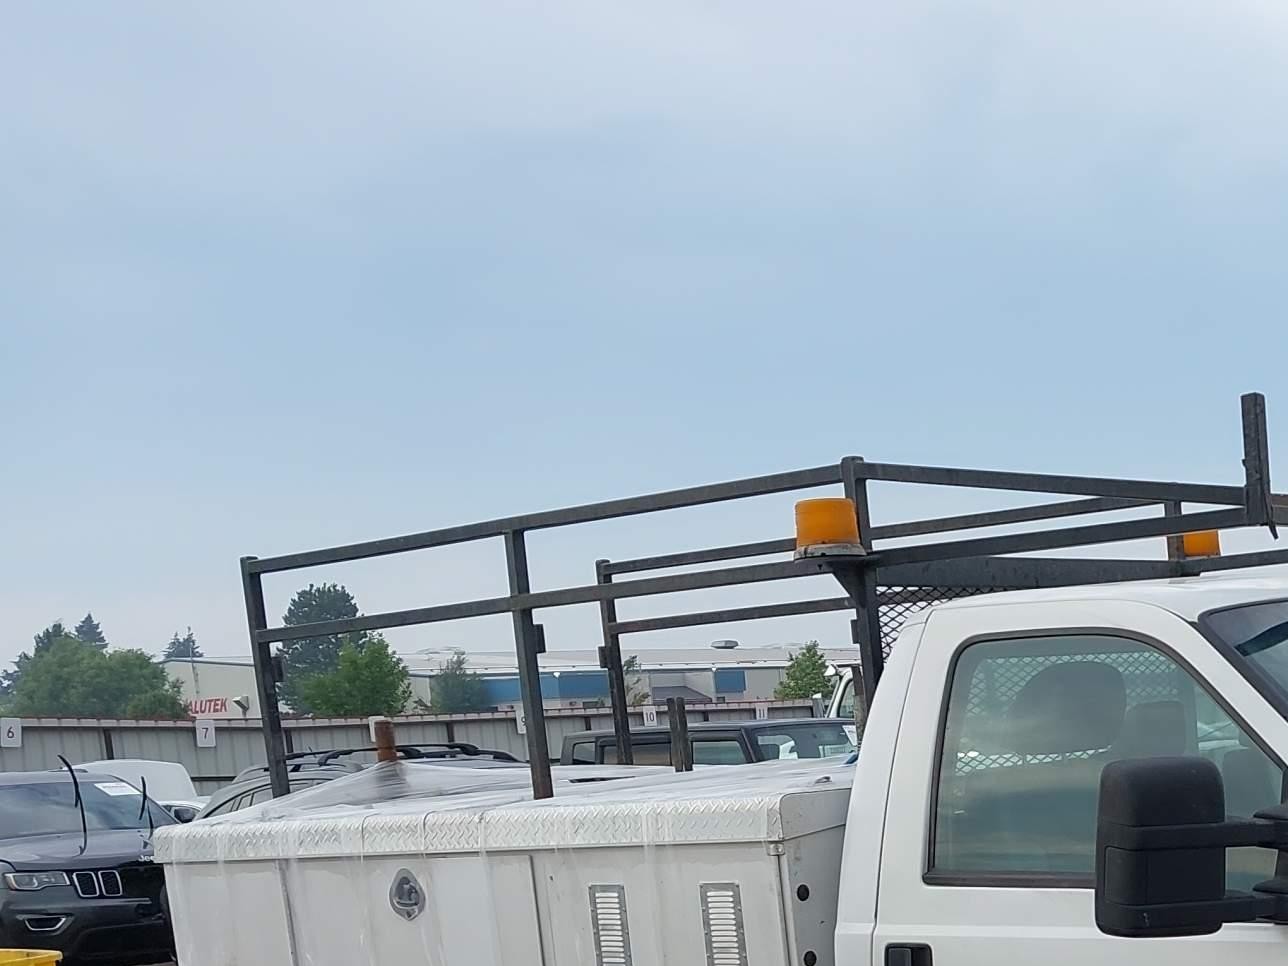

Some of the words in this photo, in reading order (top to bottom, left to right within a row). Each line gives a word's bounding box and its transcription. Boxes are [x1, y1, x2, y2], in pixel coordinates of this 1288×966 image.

[186, 698, 228, 715] ALUTEK
[644, 711, 655, 722] 10
[6, 726, 15, 739] 6
[201, 727, 209, 740] 7
